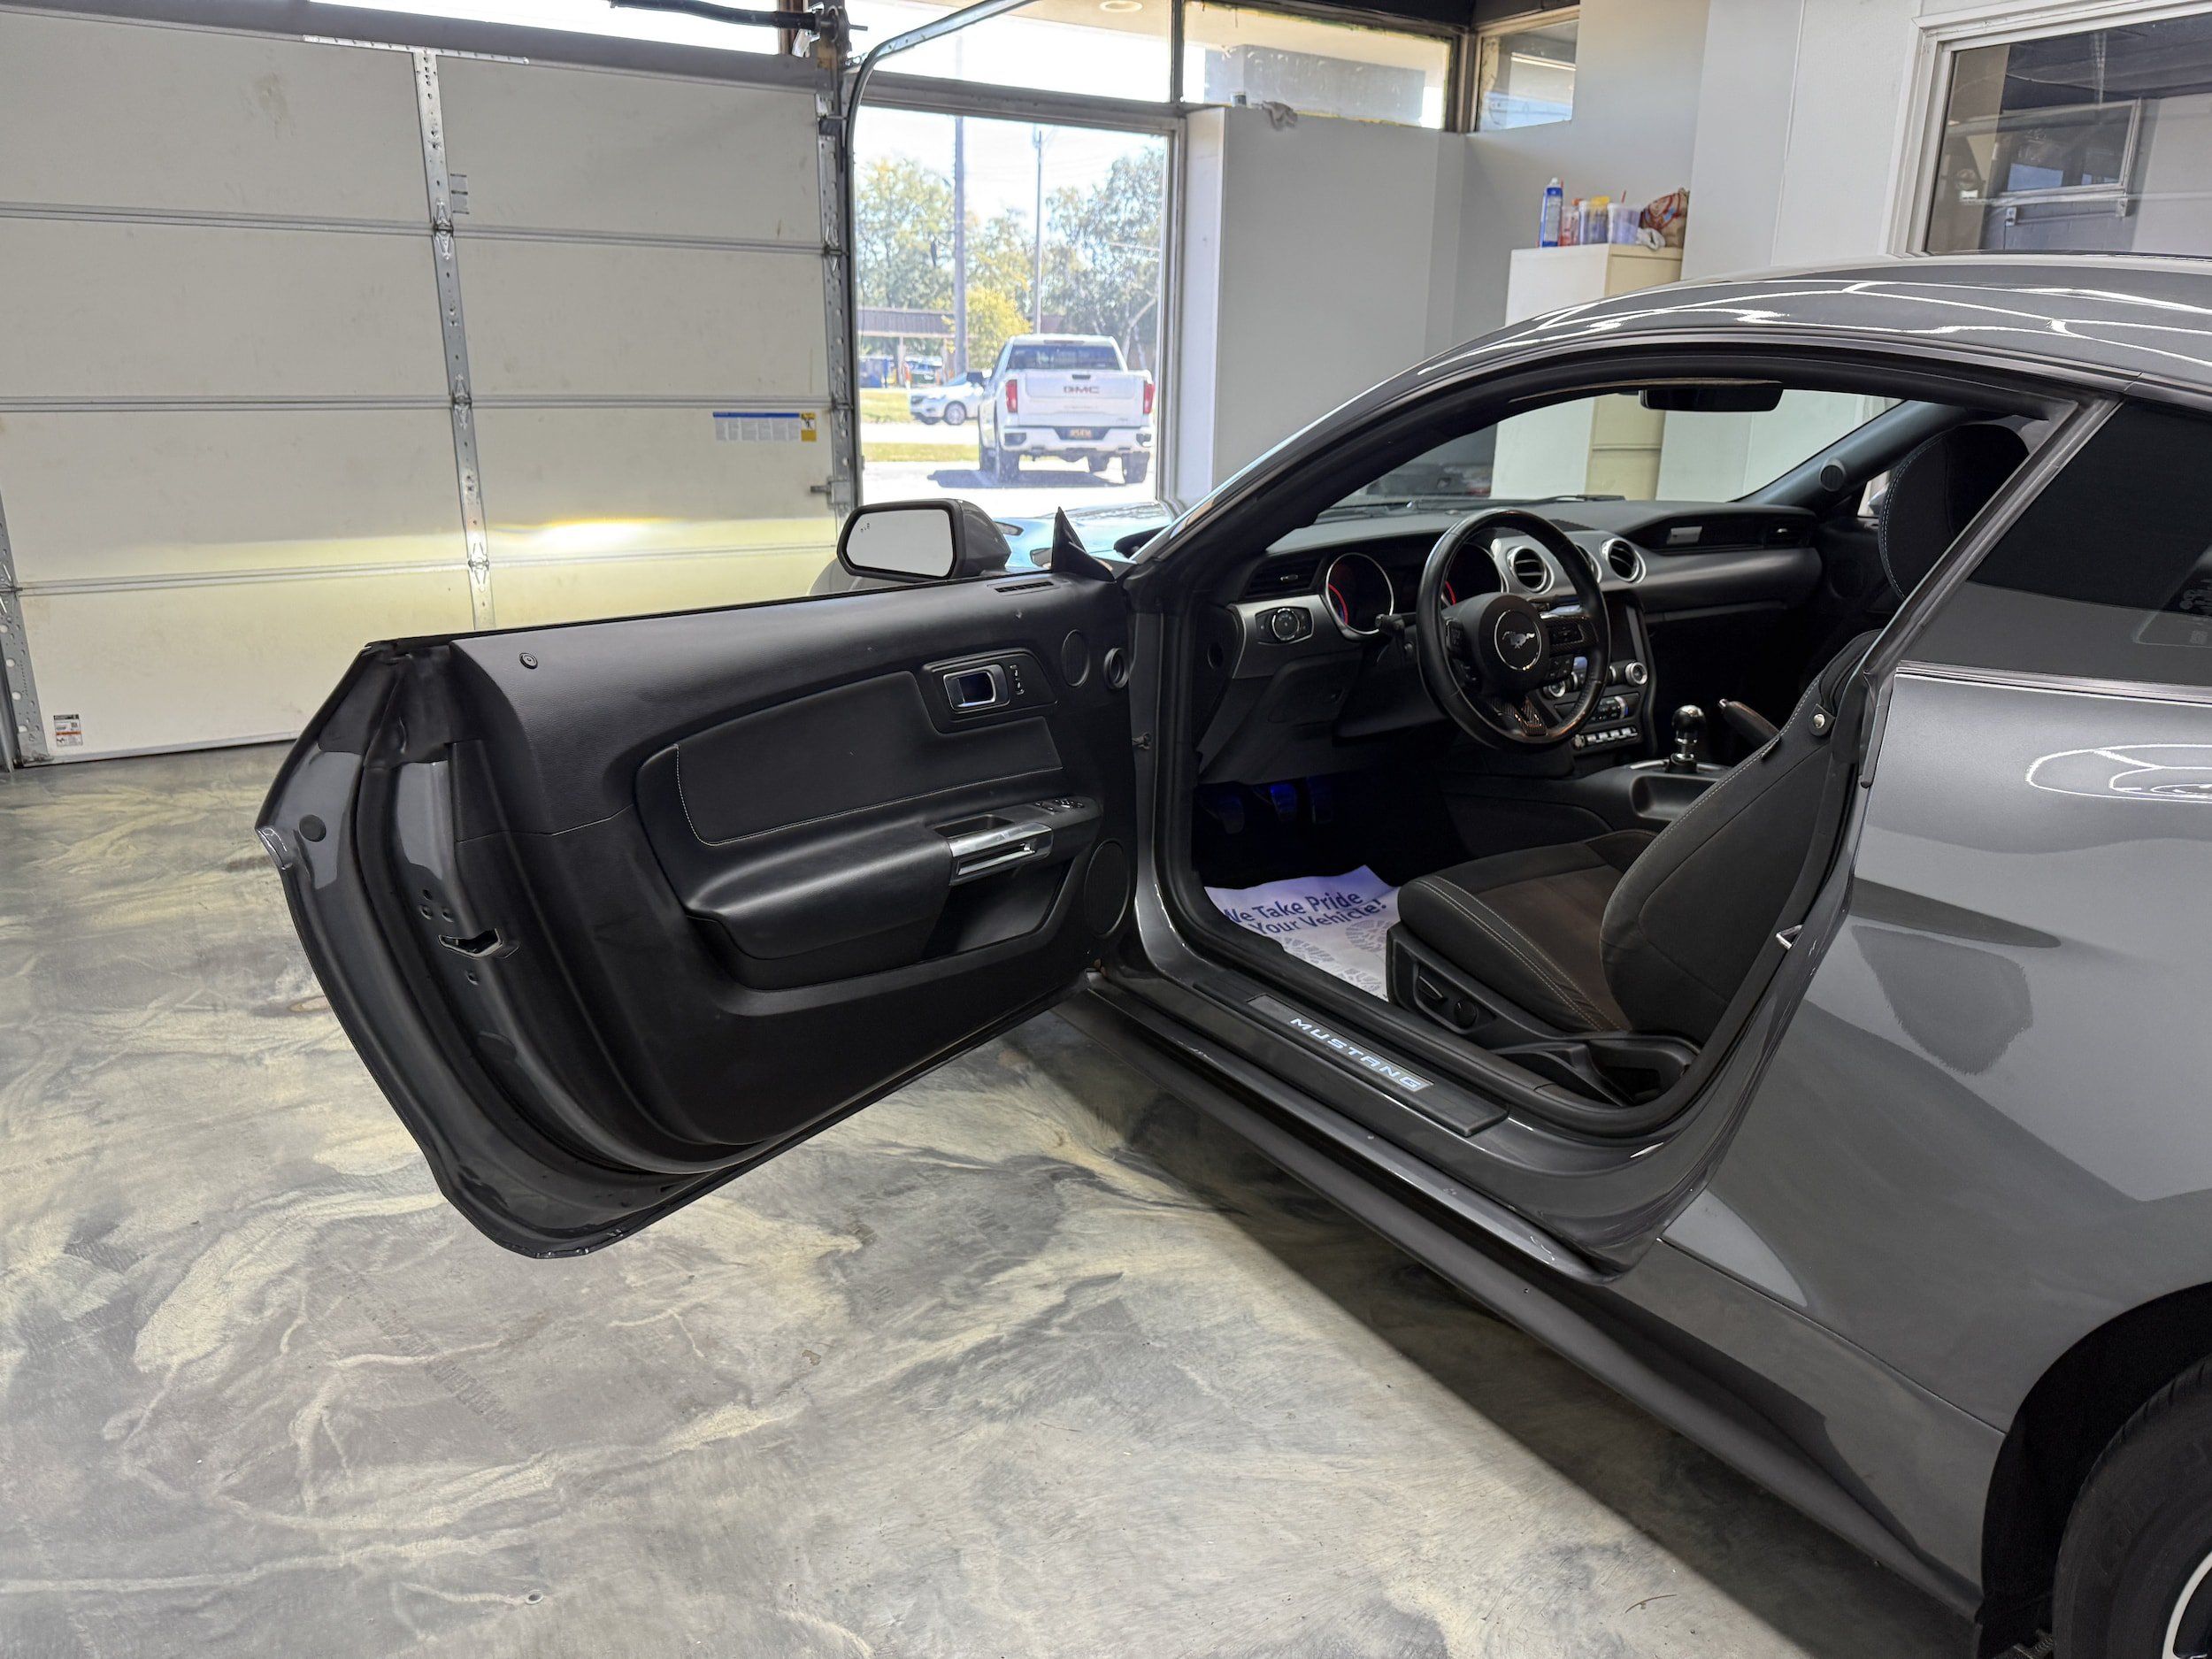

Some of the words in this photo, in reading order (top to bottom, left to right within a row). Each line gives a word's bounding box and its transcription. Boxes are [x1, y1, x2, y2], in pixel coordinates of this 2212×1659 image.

[1063, 386, 1100, 395] GMC
[1248, 920, 1302, 934] Your
[1298, 898, 1386, 927] Vehicle!
[1252, 901, 1307, 918] Take
[1304, 892, 1363, 912] Pride
[1289, 1018, 1423, 1090] MUSTANG
